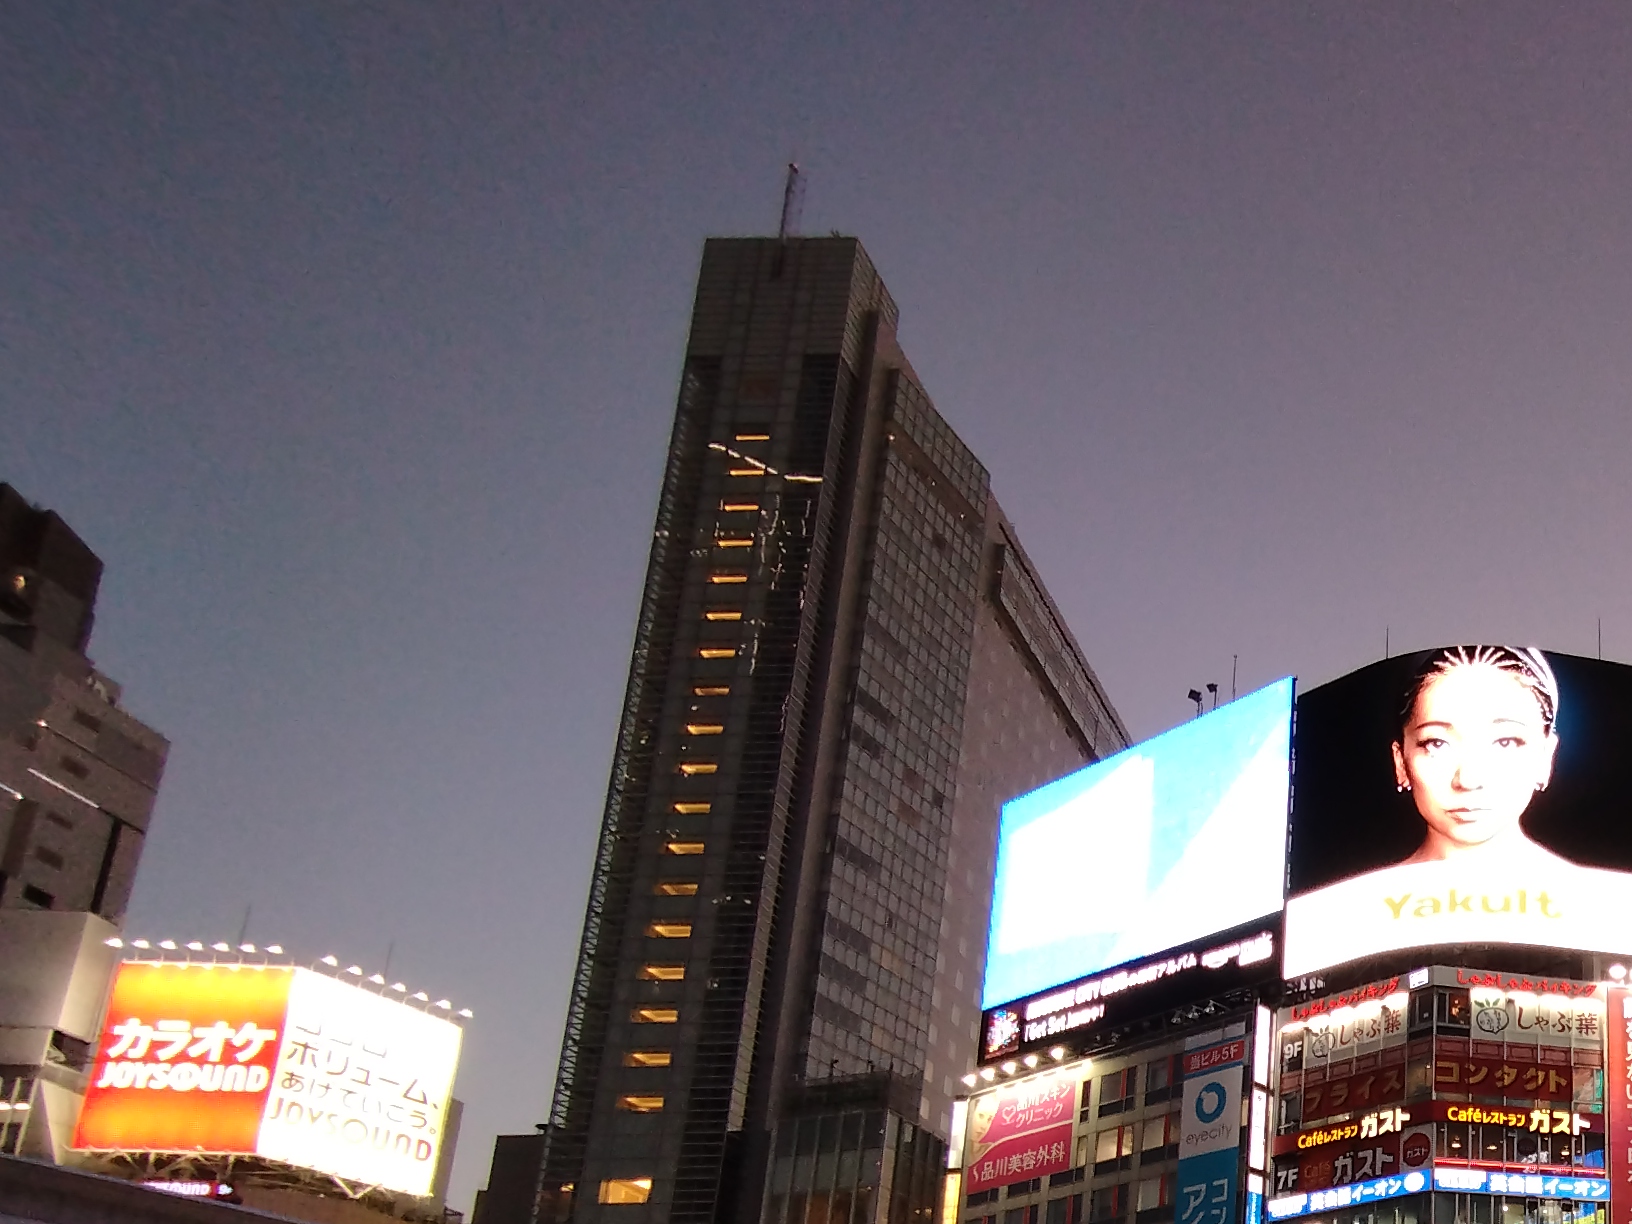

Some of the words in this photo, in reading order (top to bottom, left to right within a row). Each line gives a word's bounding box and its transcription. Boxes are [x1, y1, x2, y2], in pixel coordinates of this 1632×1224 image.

[1384, 889, 1562, 920] Yakult
[1457, 969, 1598, 997] しゃぶしゃぶバイキング
[1340, 1009, 1402, 1046] しゃぶ葉
[1517, 1006, 1598, 1036] しゃぶ葉
[107, 1018, 277, 1063] カラオケ
[1284, 1041, 1303, 1060] 9F
[97, 1061, 270, 1092] JOYSOUND
[1436, 1060, 1568, 1093] コンタクト
[1015, 1102, 1063, 1128] クリニック
[1360, 1108, 1410, 1139] ガスト
[1447, 1106, 1526, 1127] Caféレストラン
[1529, 1109, 1591, 1135] ガスト
[1186, 1123, 1232, 1145] eyecity
[981, 1141, 1066, 1182] 品川美容外科
[1333, 1147, 1394, 1186] ガスト
[1277, 1168, 1298, 1190] 7F
